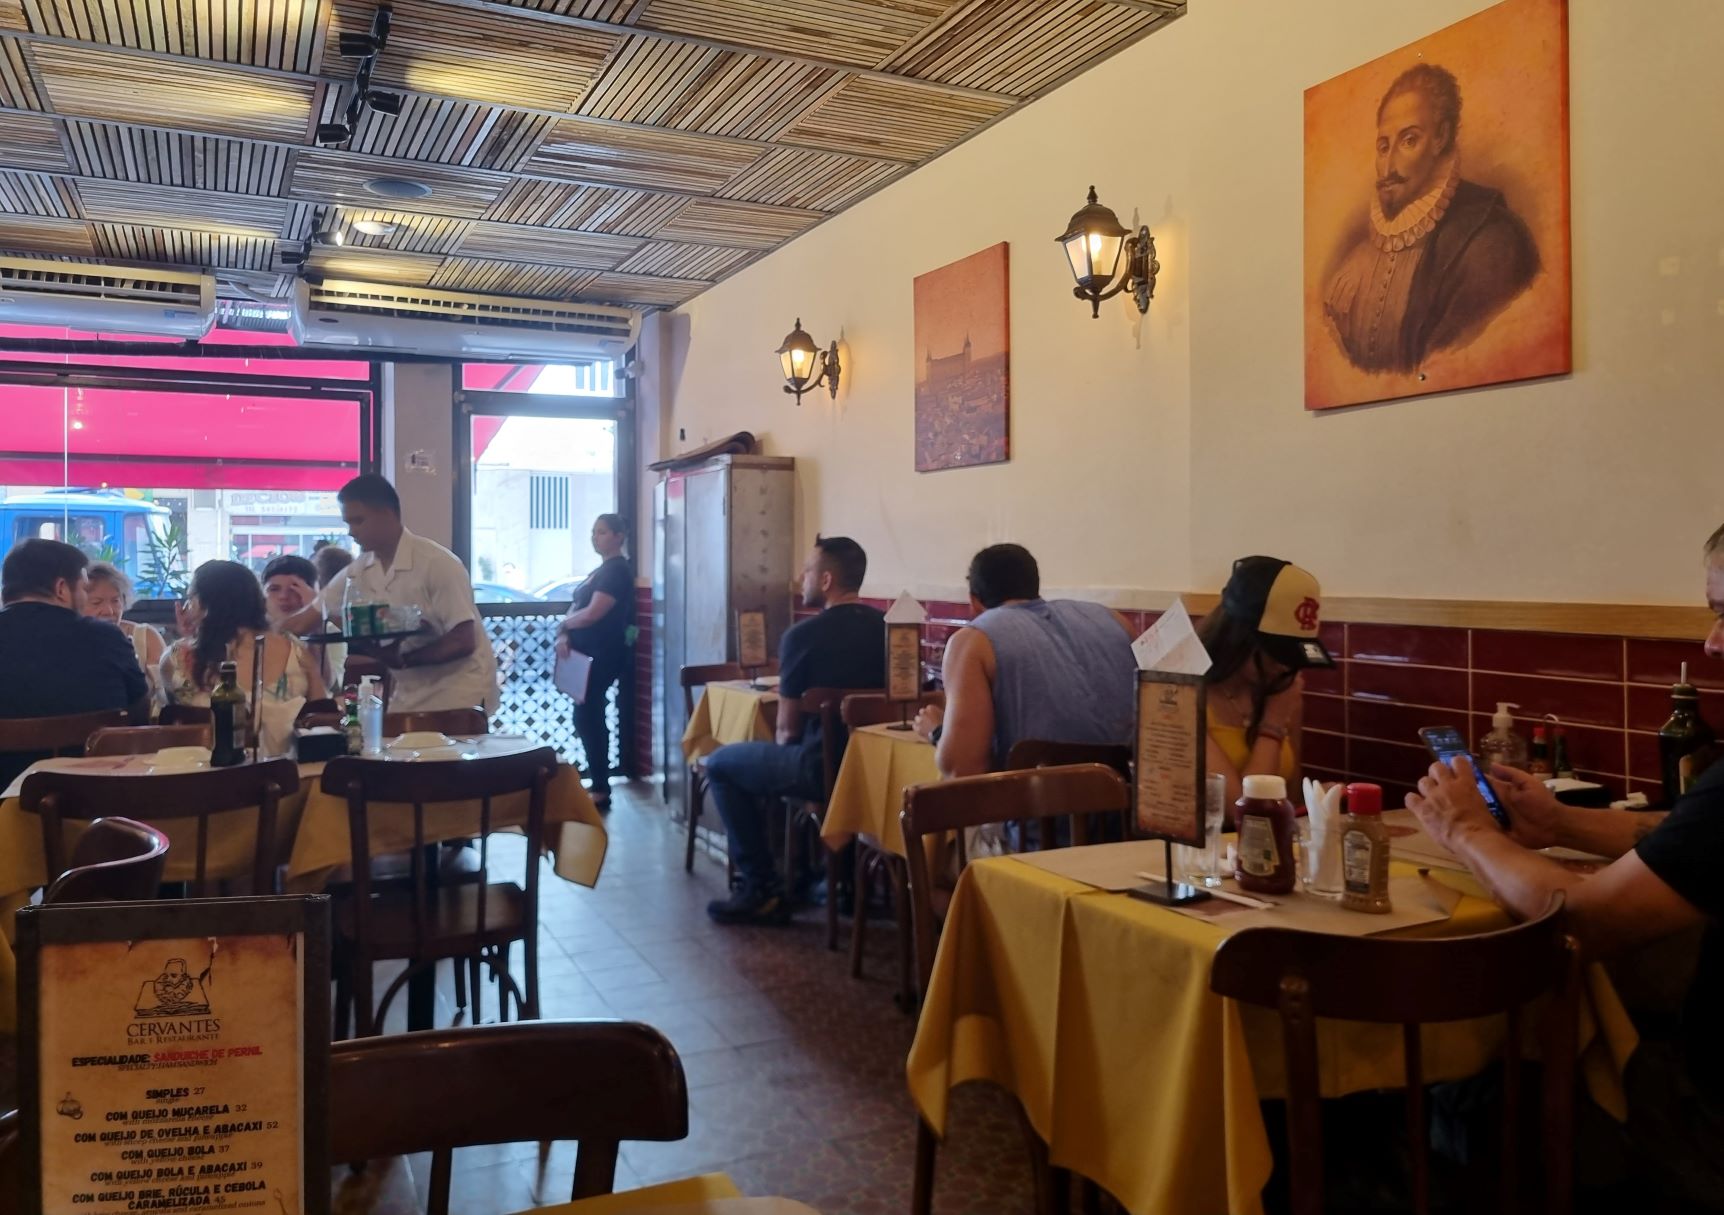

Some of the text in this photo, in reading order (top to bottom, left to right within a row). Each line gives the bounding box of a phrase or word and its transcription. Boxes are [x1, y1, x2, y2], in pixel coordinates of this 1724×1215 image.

[126, 1018, 221, 1038] CERVANTES
[128, 1037, 146, 1046] BAR
[211, 1048, 225, 1059] DE
[145, 1086, 206, 1100] SIMPLES 27
[105, 1111, 128, 1122] COM
[131, 1108, 169, 1120] QUEIJO
[235, 1104, 248, 1112] 32
[74, 1121, 279, 1143] COM QUEIJO DE OVELHA E ABACAXI 52
[121, 1144, 230, 1161] COM QUEIJO BOLA 37
[90, 1171, 113, 1183] COM
[116, 1168, 154, 1180] QUEIJO
[156, 1166, 185, 1178] BOLA
[187, 1165, 196, 1176] E
[198, 1161, 248, 1175] ABACAXI
[72, 1192, 95, 1204] COM
[97, 1190, 136, 1203] QUEIJO
[168, 1184, 210, 1198] RÚCULA
[213, 1183, 221, 1194] E
[224, 1179, 266, 1193] CEBOLA
[127, 1195, 211, 1211] CARAMELIZADA
